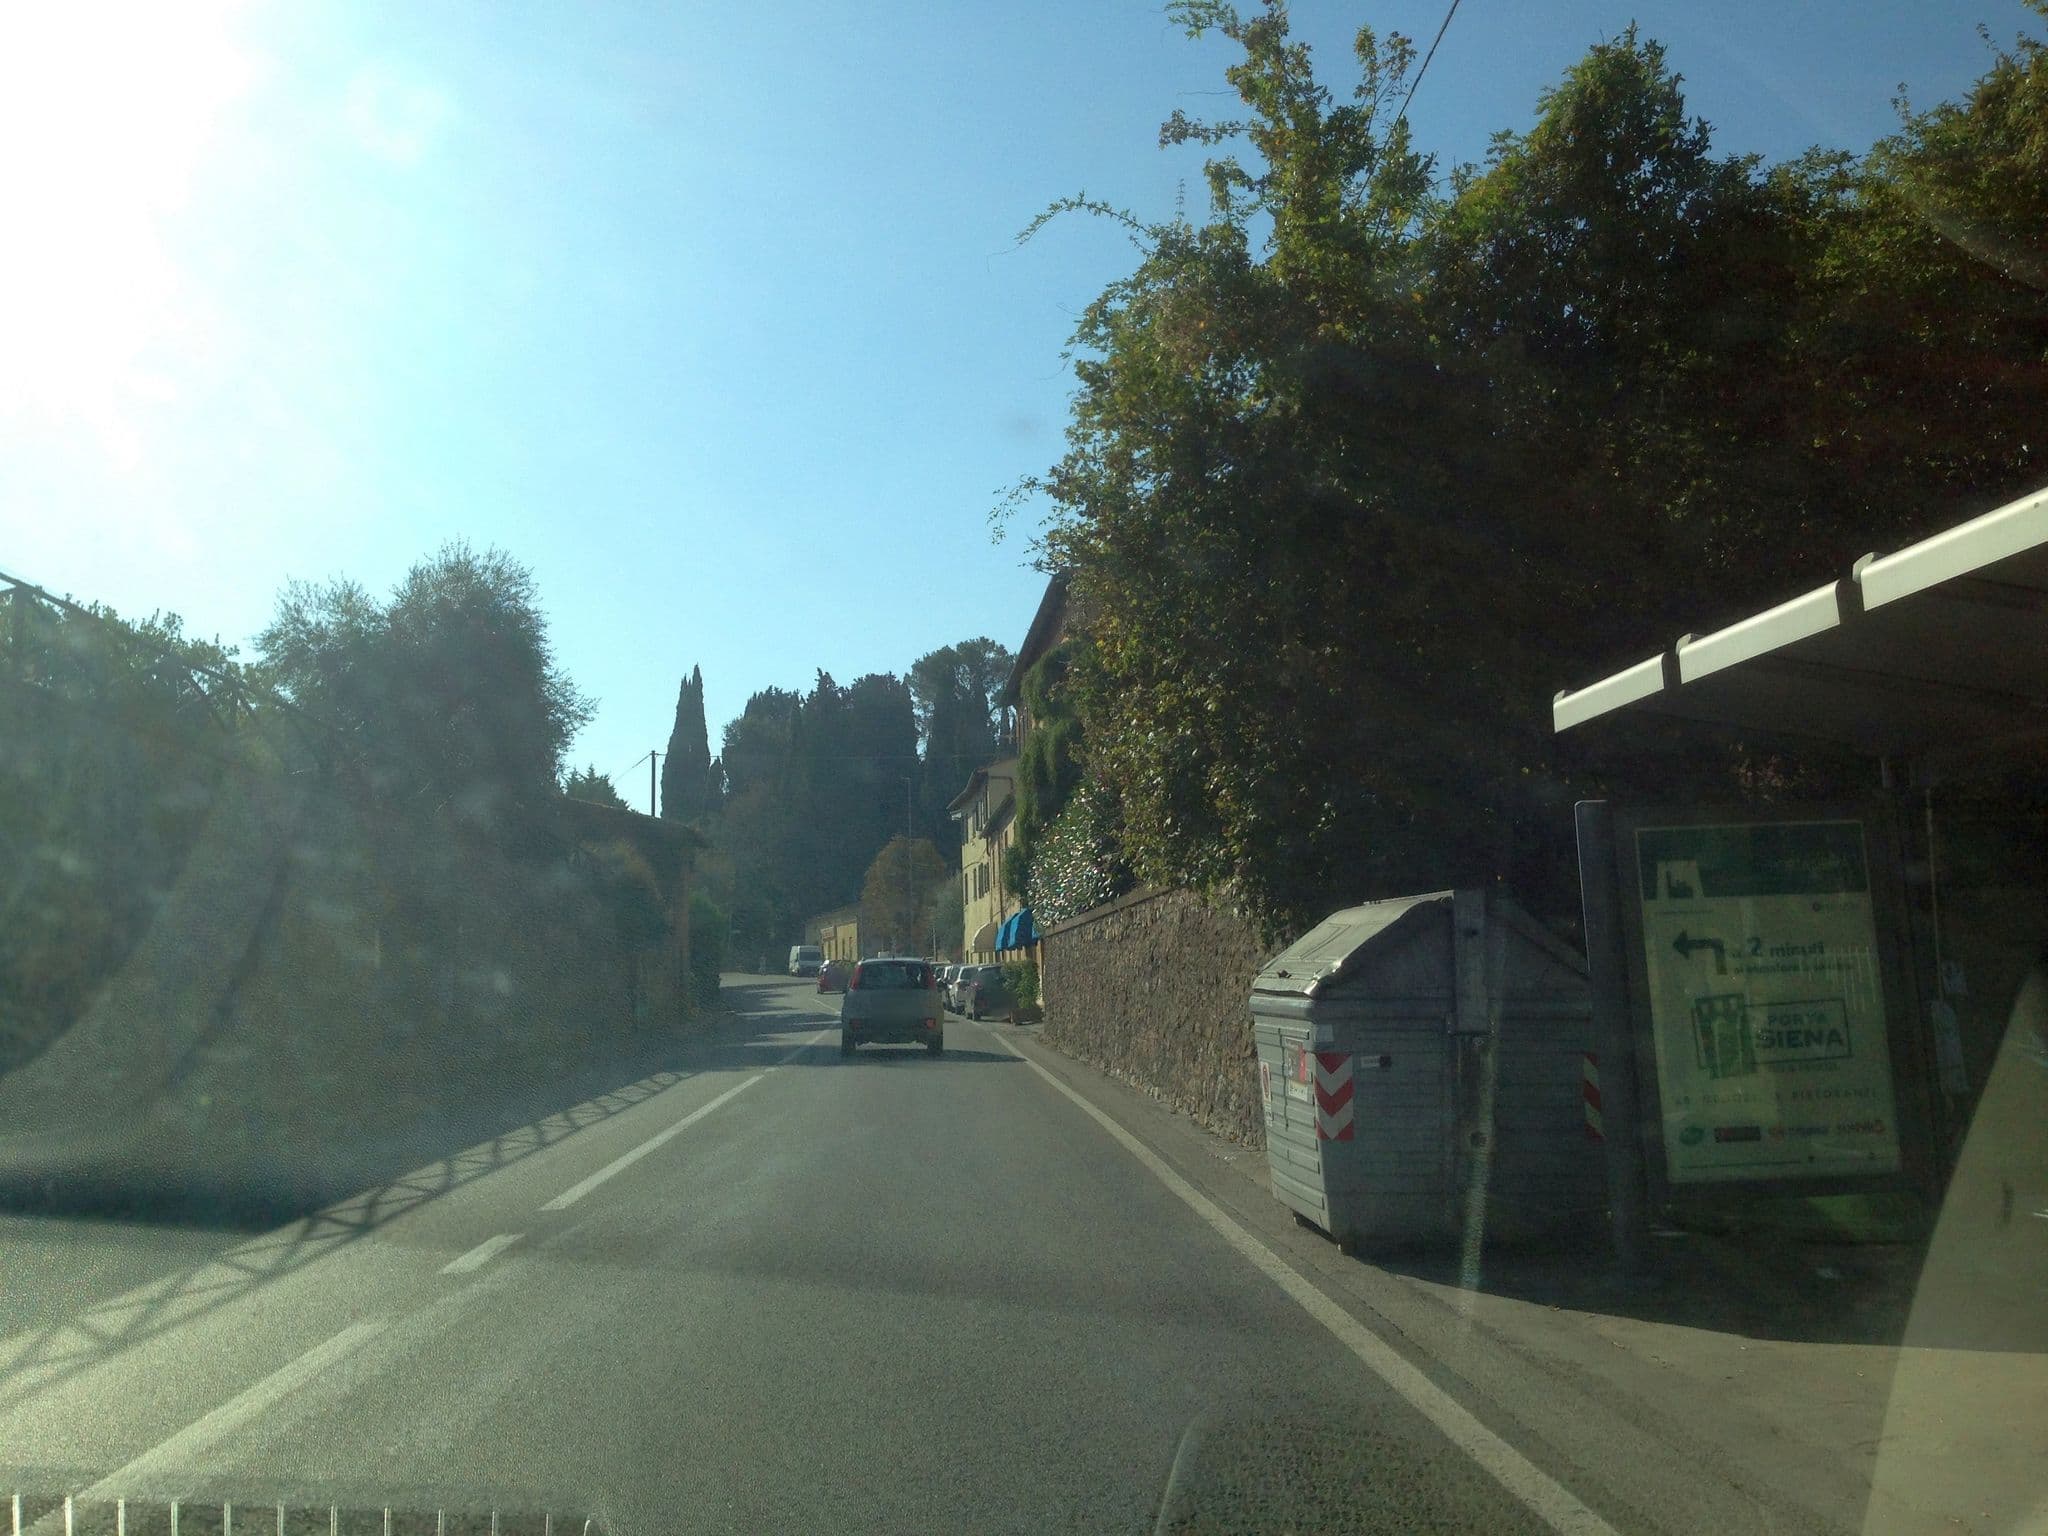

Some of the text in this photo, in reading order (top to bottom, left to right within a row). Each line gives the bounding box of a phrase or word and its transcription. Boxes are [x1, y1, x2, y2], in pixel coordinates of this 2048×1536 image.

[1746, 936, 1764, 958] 2
[1770, 940, 1825, 958] minuti
[1766, 1011, 1827, 1028] PORTA
[1755, 1028, 1843, 1049] SIENA
